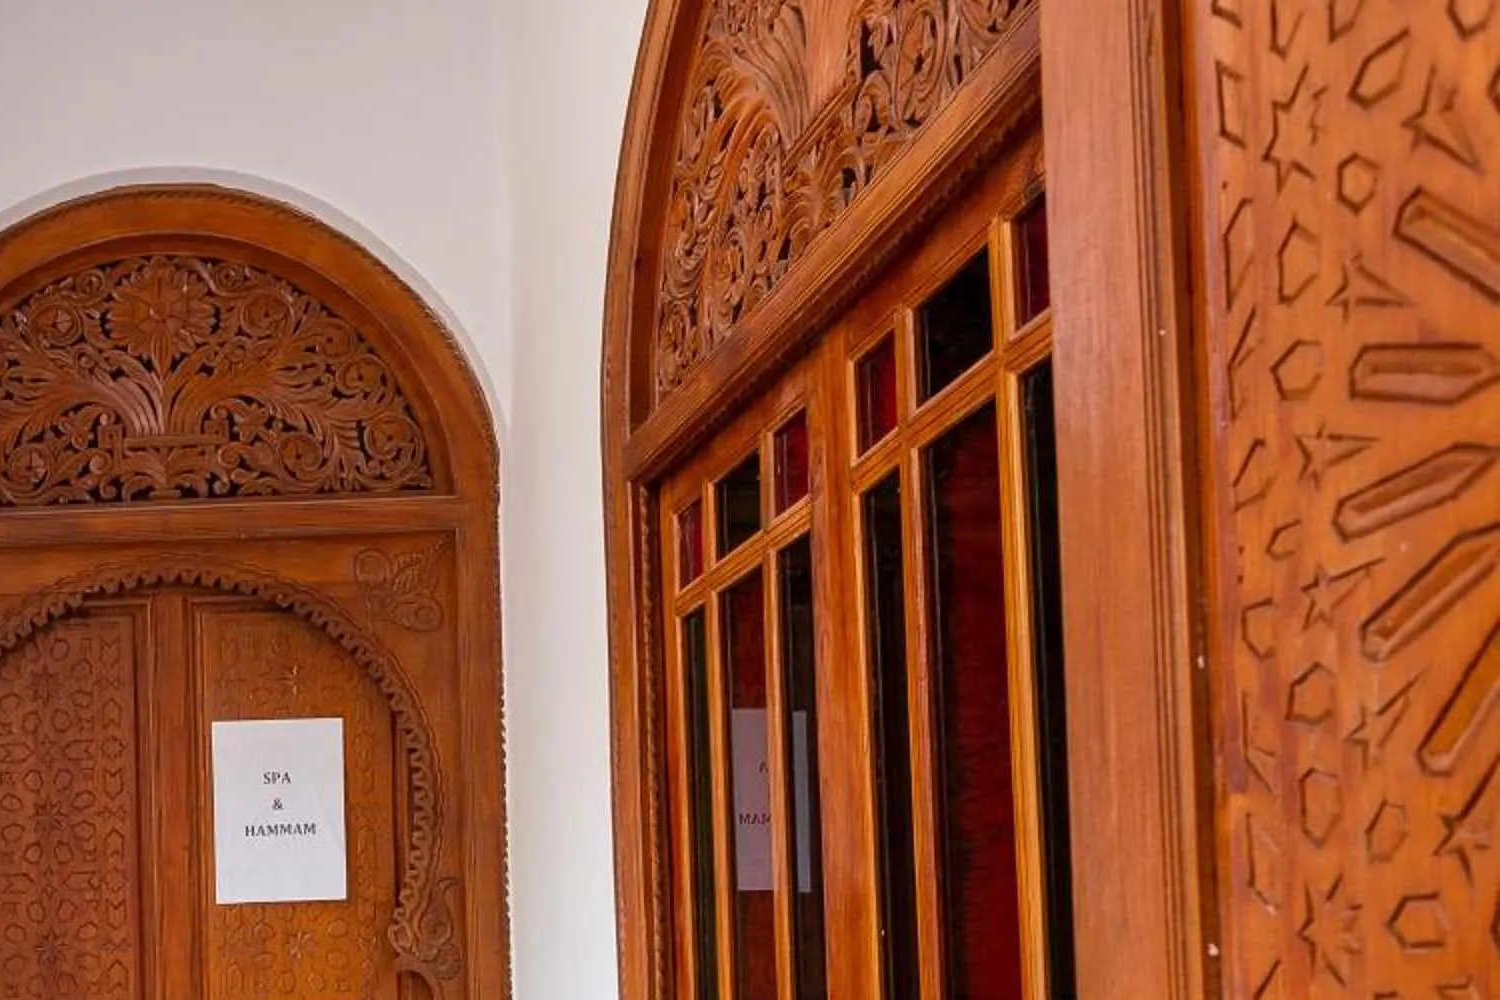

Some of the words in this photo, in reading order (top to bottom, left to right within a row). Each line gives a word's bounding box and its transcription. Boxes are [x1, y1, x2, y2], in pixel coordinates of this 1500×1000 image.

[263, 771, 291, 785] SPA
[271, 798, 284, 811] &
[245, 822, 317, 837] HAMMAM
